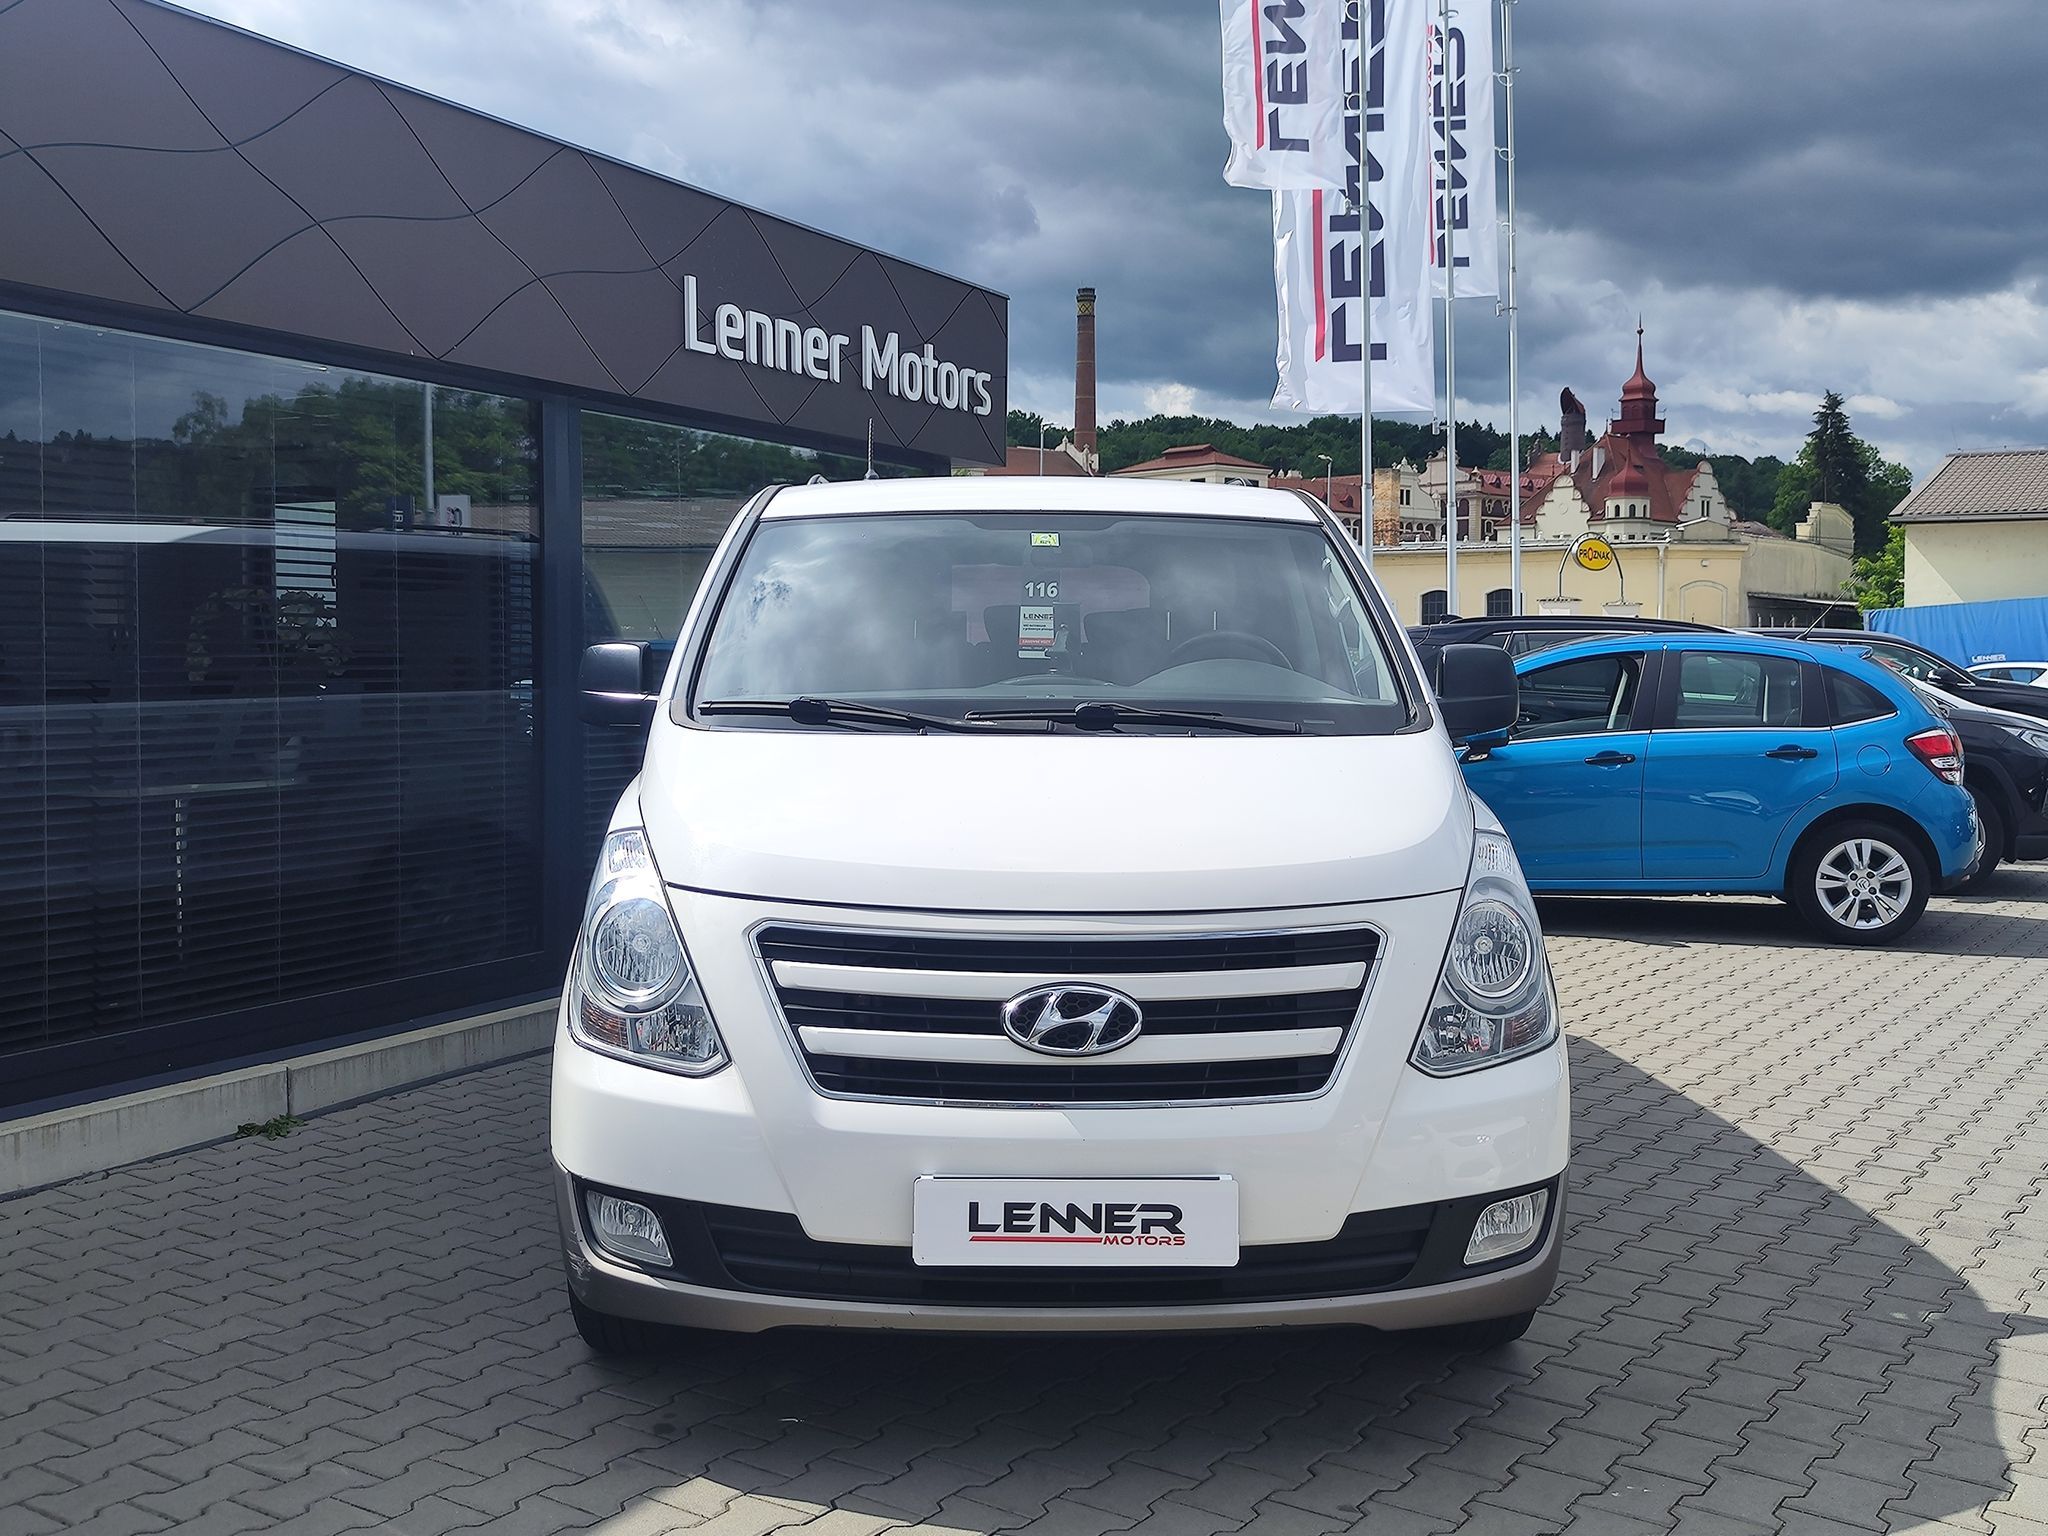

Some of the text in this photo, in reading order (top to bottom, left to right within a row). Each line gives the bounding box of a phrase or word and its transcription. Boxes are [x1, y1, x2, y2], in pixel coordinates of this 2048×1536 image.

[683, 274, 993, 417] Lenner Motors
[1024, 582, 1059, 598] 116
[968, 1201, 1186, 1235] LENNER
[1102, 1235, 1186, 1246] MOTORS
